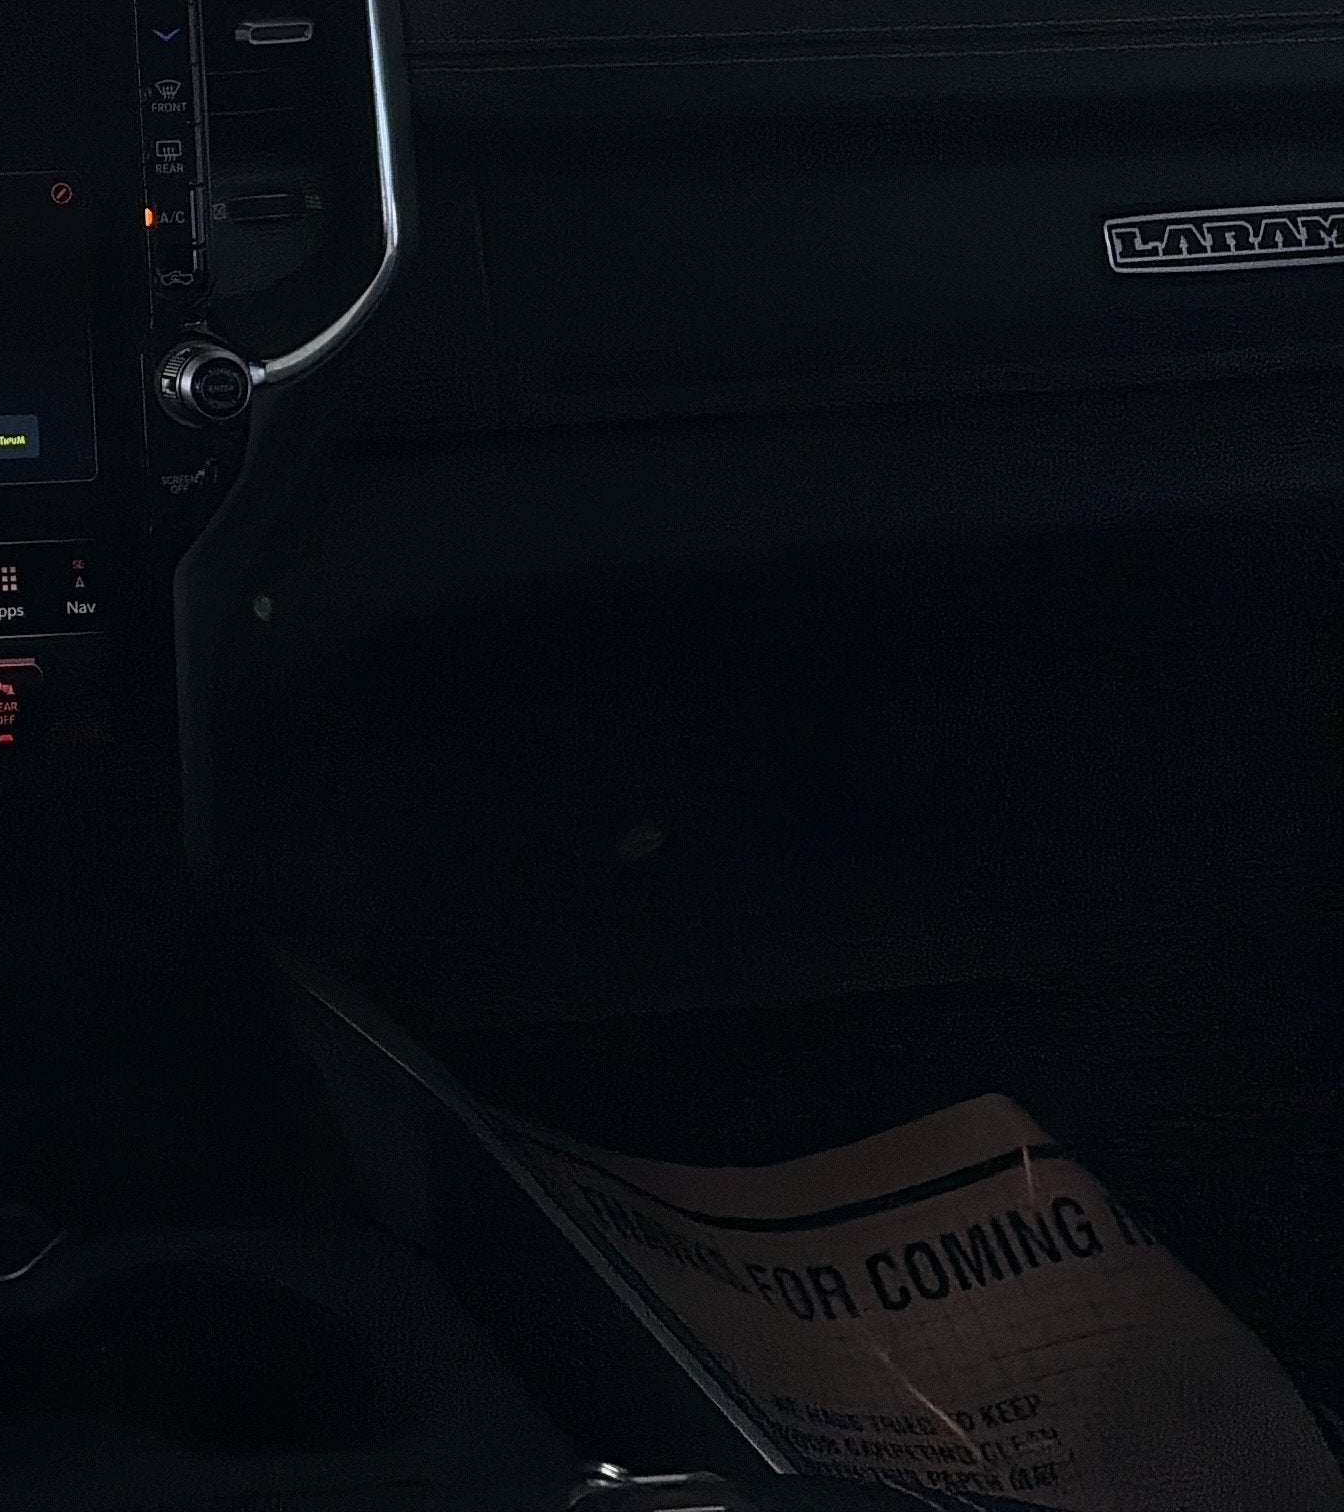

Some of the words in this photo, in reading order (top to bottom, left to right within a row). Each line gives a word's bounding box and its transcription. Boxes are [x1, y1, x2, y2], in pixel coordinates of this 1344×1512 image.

[150, 101, 188, 114] FRONT
[155, 162, 185, 175] REAR
[158, 210, 187, 225] A/C
[66, 600, 97, 615] Nav
[746, 1262, 859, 1321] FOR
[864, 1195, 1105, 1312] COMING
[978, 1393, 1041, 1429] KEEP
